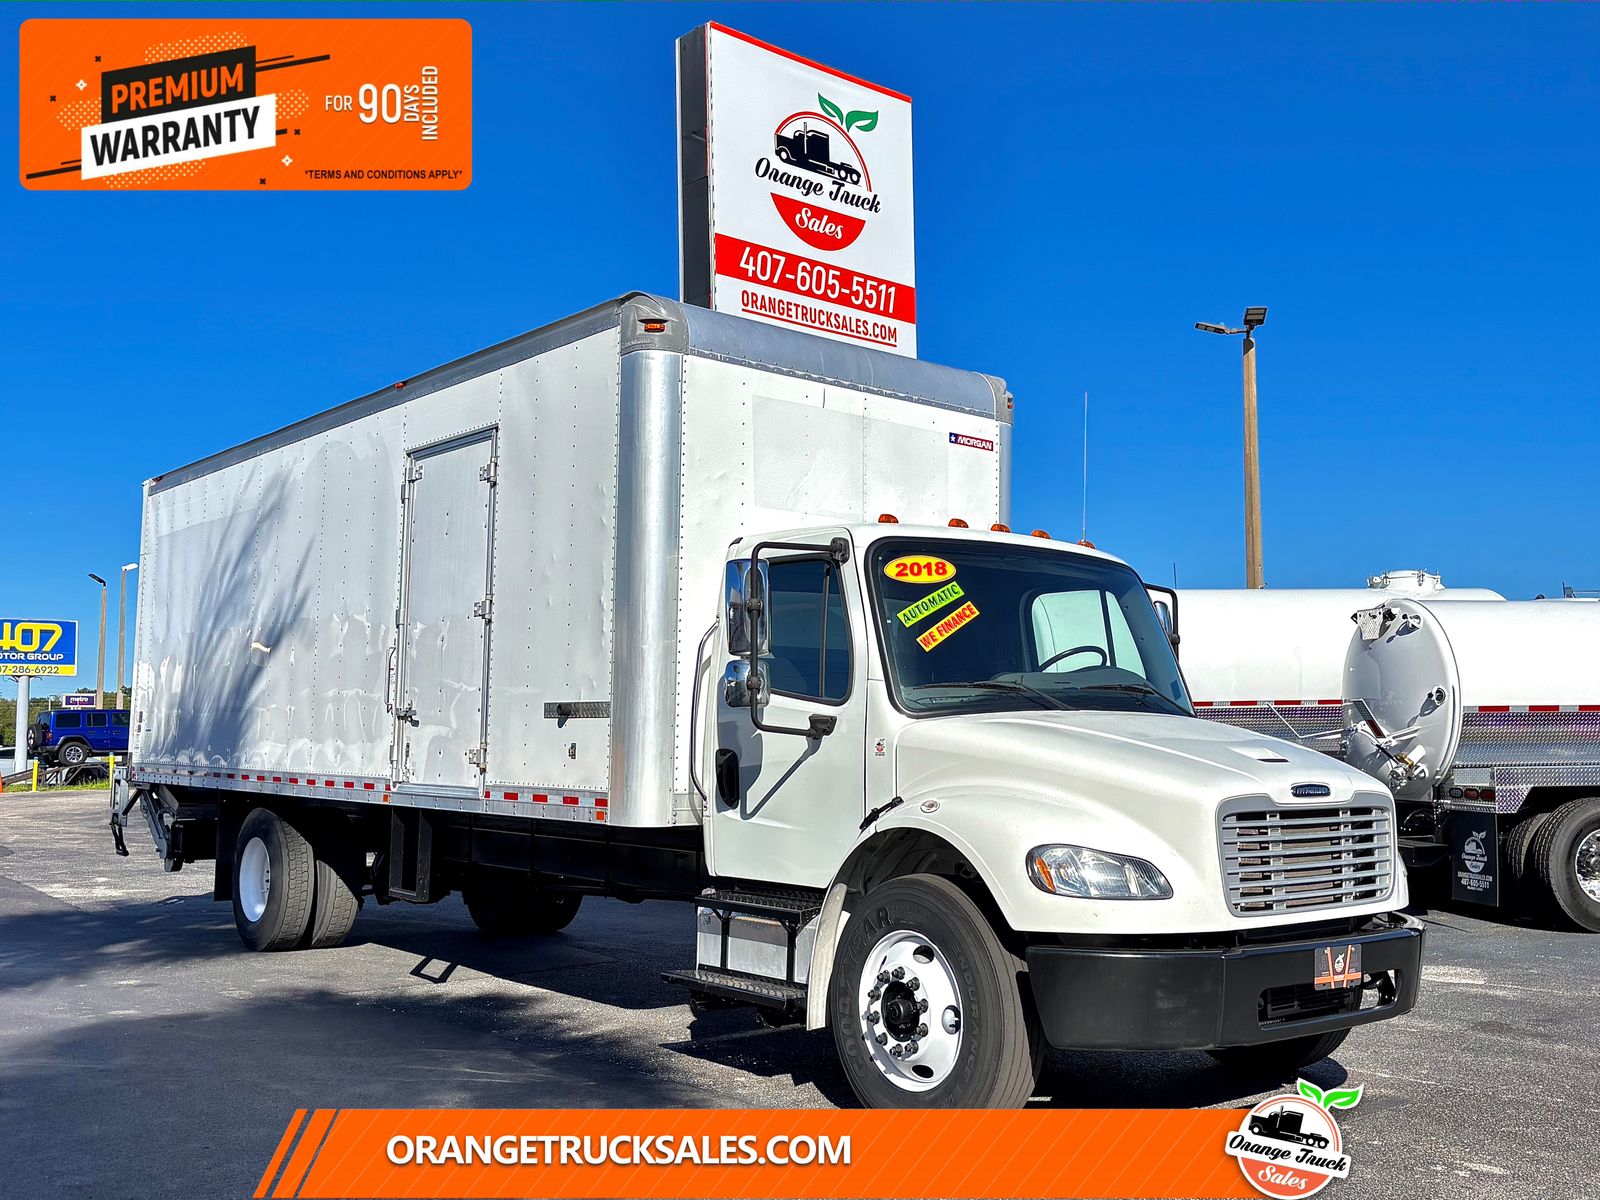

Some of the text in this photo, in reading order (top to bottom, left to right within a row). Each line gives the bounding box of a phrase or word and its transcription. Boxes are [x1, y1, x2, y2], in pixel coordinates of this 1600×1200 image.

[754, 157, 881, 214] Orange Truck
[795, 207, 843, 239] Sales
[739, 246, 896, 313] 407-605-5511
[741, 290, 897, 343] ORANGETRUCKSALES.COM
[957, 436, 992, 450] MORGAN
[895, 561, 947, 577] 2018
[902, 584, 960, 624] AUTOMATIC
[919, 603, 977, 649] WE FINANCE
[0, 665, 60, 674] 7-286-6922
[27, 653, 64, 661] GROUP
